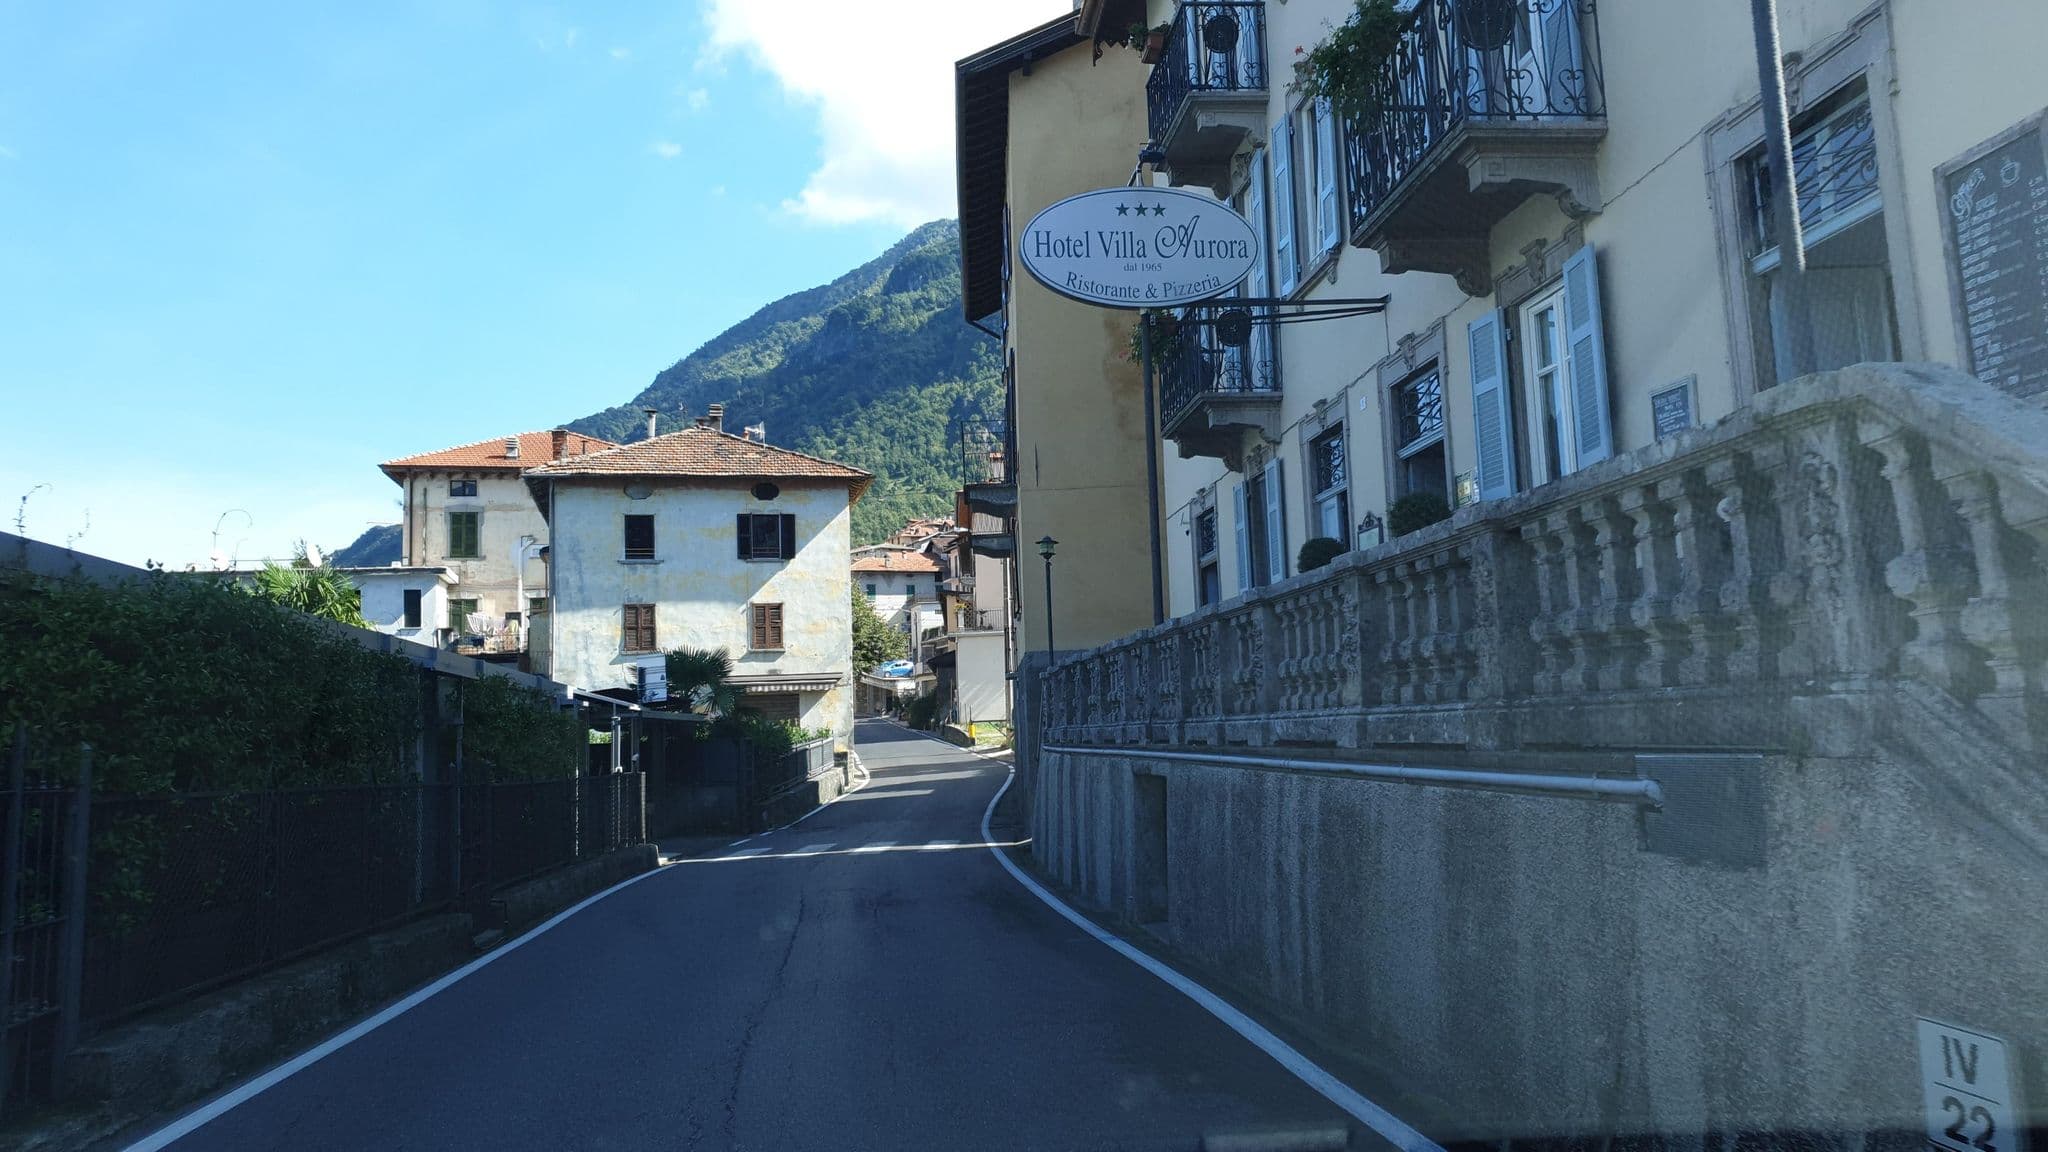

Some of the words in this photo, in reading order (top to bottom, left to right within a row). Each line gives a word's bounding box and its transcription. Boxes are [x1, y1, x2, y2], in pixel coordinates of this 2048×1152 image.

[1034, 230, 1091, 258] Hotel
[1098, 230, 1147, 259] Villa
[1155, 215, 1249, 259] Aurora
[1066, 271, 1140, 299] Ristorante
[1145, 283, 1159, 299] &
[1163, 274, 1221, 298] Pizzeria
[1123, 263, 1137, 272] dal
[1141, 263, 1162, 272] 1965
[1941, 1035, 1979, 1085] IV
[1942, 1096, 1997, 1152] 22
